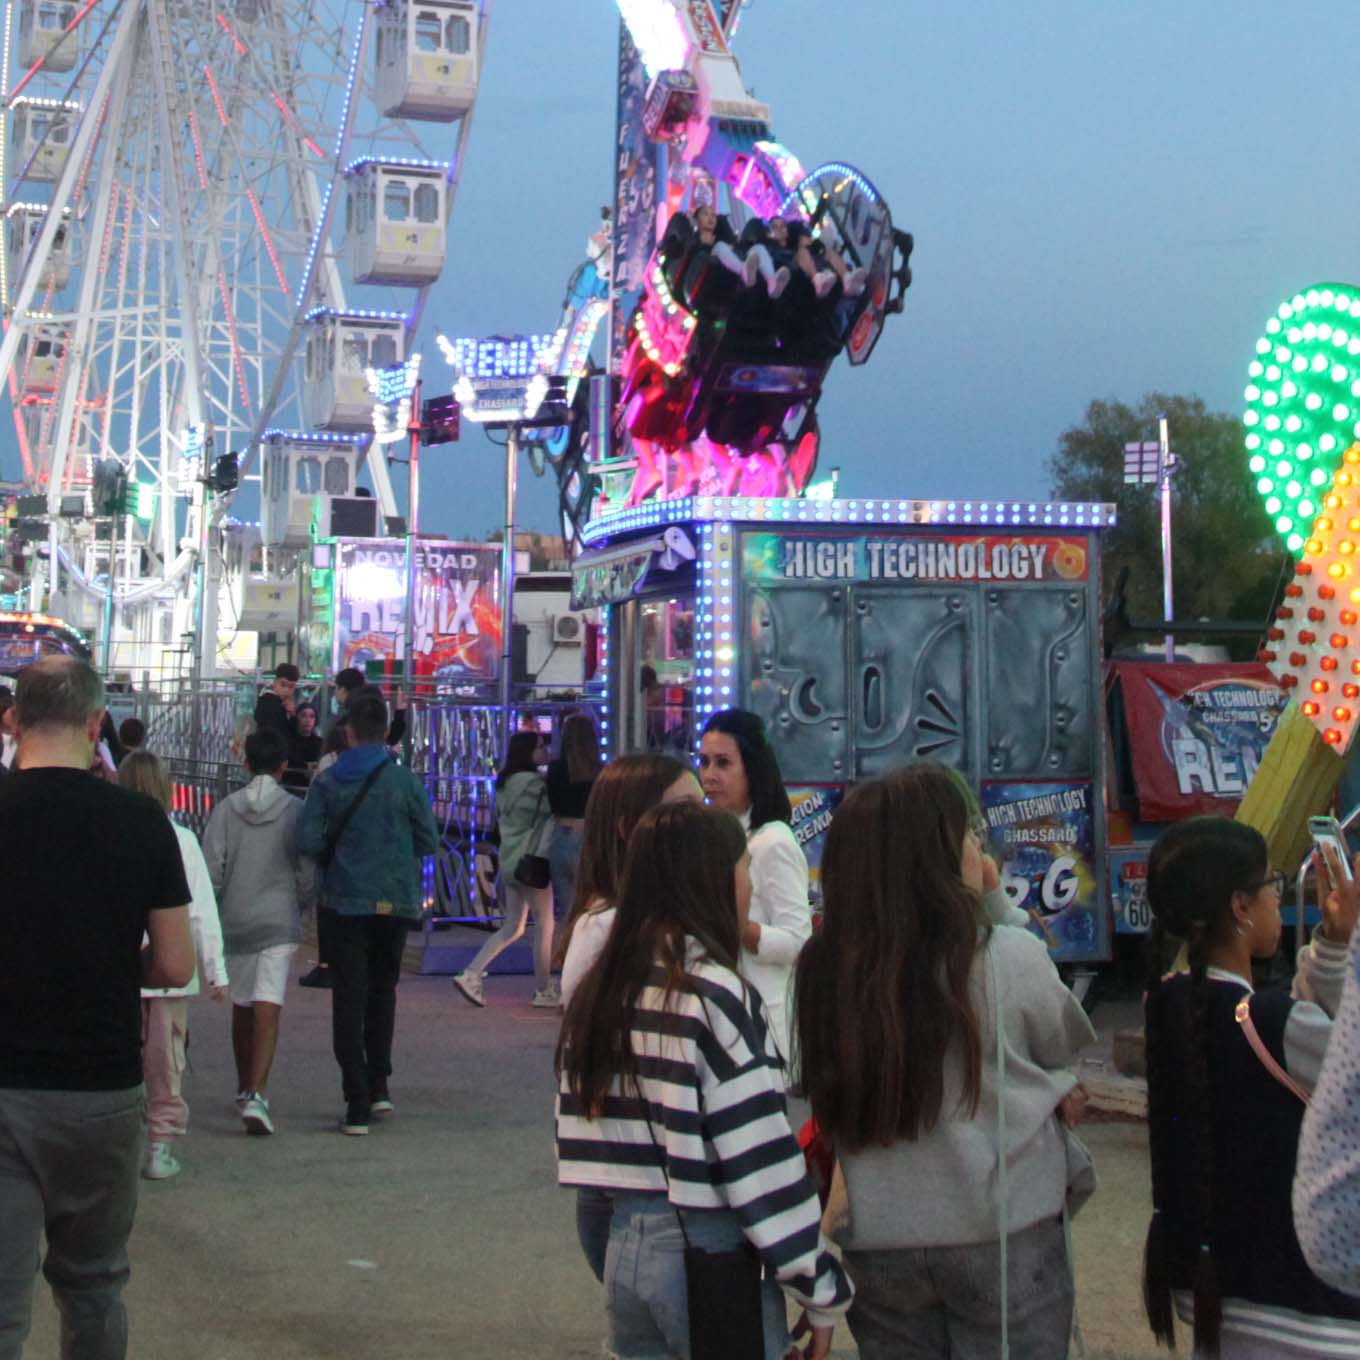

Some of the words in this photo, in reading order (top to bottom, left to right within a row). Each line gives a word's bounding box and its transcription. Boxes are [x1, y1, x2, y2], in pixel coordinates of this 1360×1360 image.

[354, 550, 478, 569] NOVEDAD
[784, 541, 856, 578] HIGH
[867, 542, 1048, 580] TECHNOLOGY
[1213, 689, 1281, 707] TECHNOLOGY
[987, 803, 1017, 828] HIGH
[1016, 788, 1086, 821] TECHNOLOGY
[793, 808, 834, 848] REMA
[1127, 899, 1152, 928] 60
